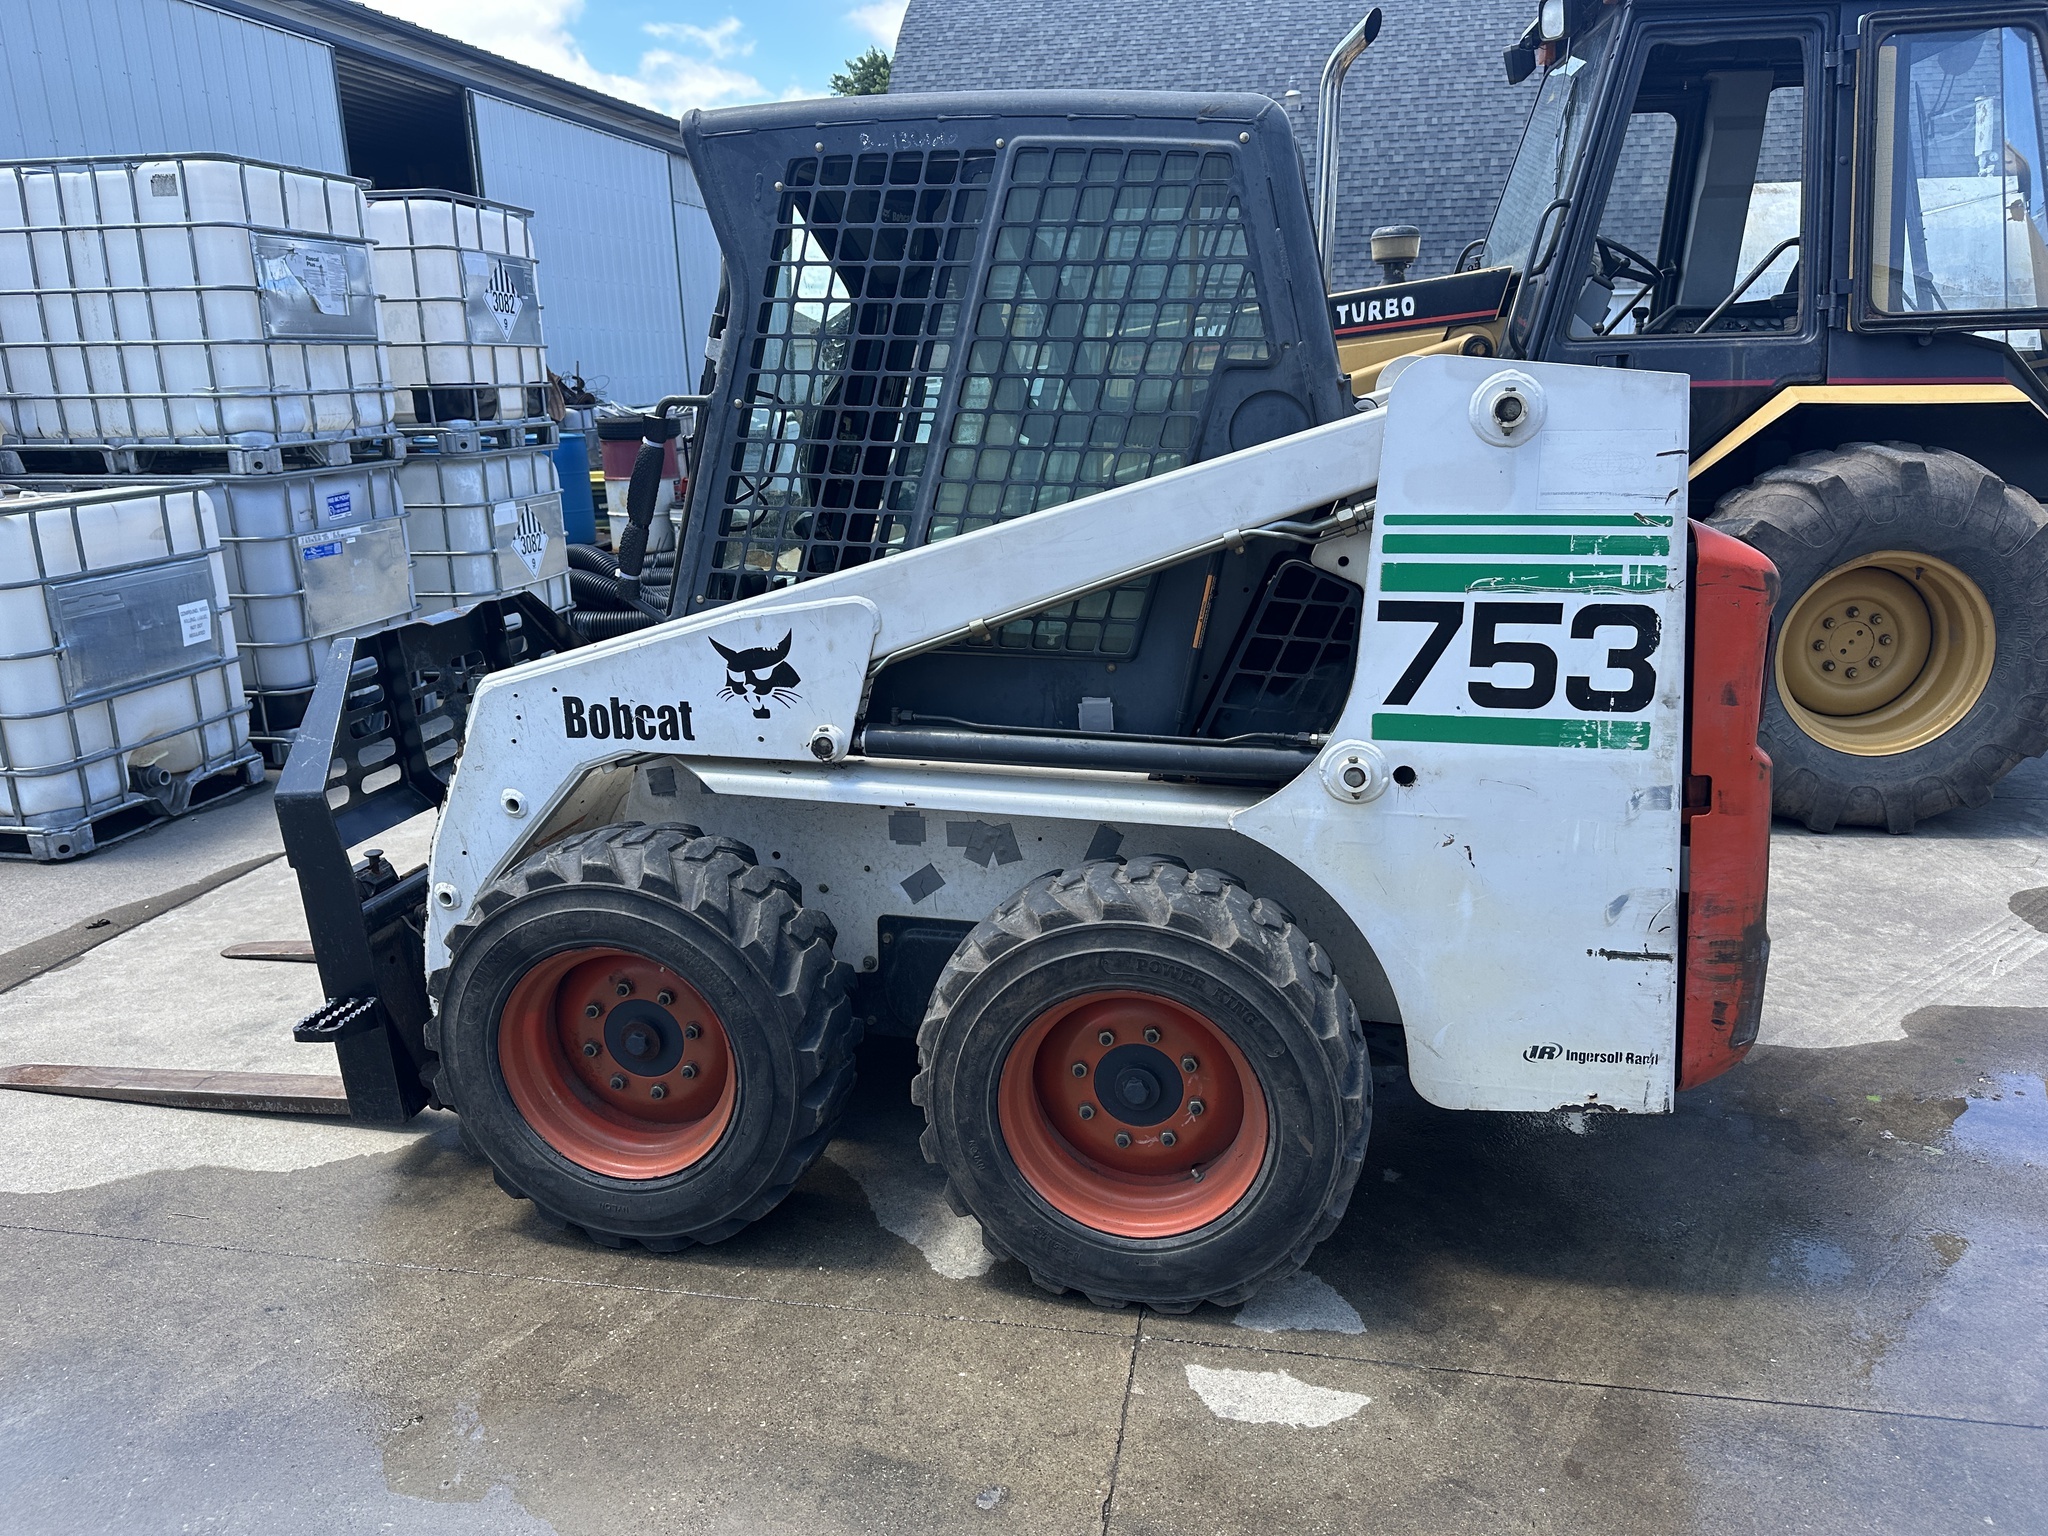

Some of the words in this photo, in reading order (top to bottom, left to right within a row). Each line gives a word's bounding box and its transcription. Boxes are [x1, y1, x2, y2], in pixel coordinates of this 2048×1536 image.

[492, 291, 516, 315] 3082
[1336, 296, 1415, 325] TURBO
[520, 533, 543, 555] 3082
[1376, 599, 1662, 713] 753
[562, 696, 695, 741] Bobcat
[1136, 957, 1206, 993] POWER
[1211, 986, 1262, 1026] KING
[1566, 1049, 1623, 1064] Ingersoll
